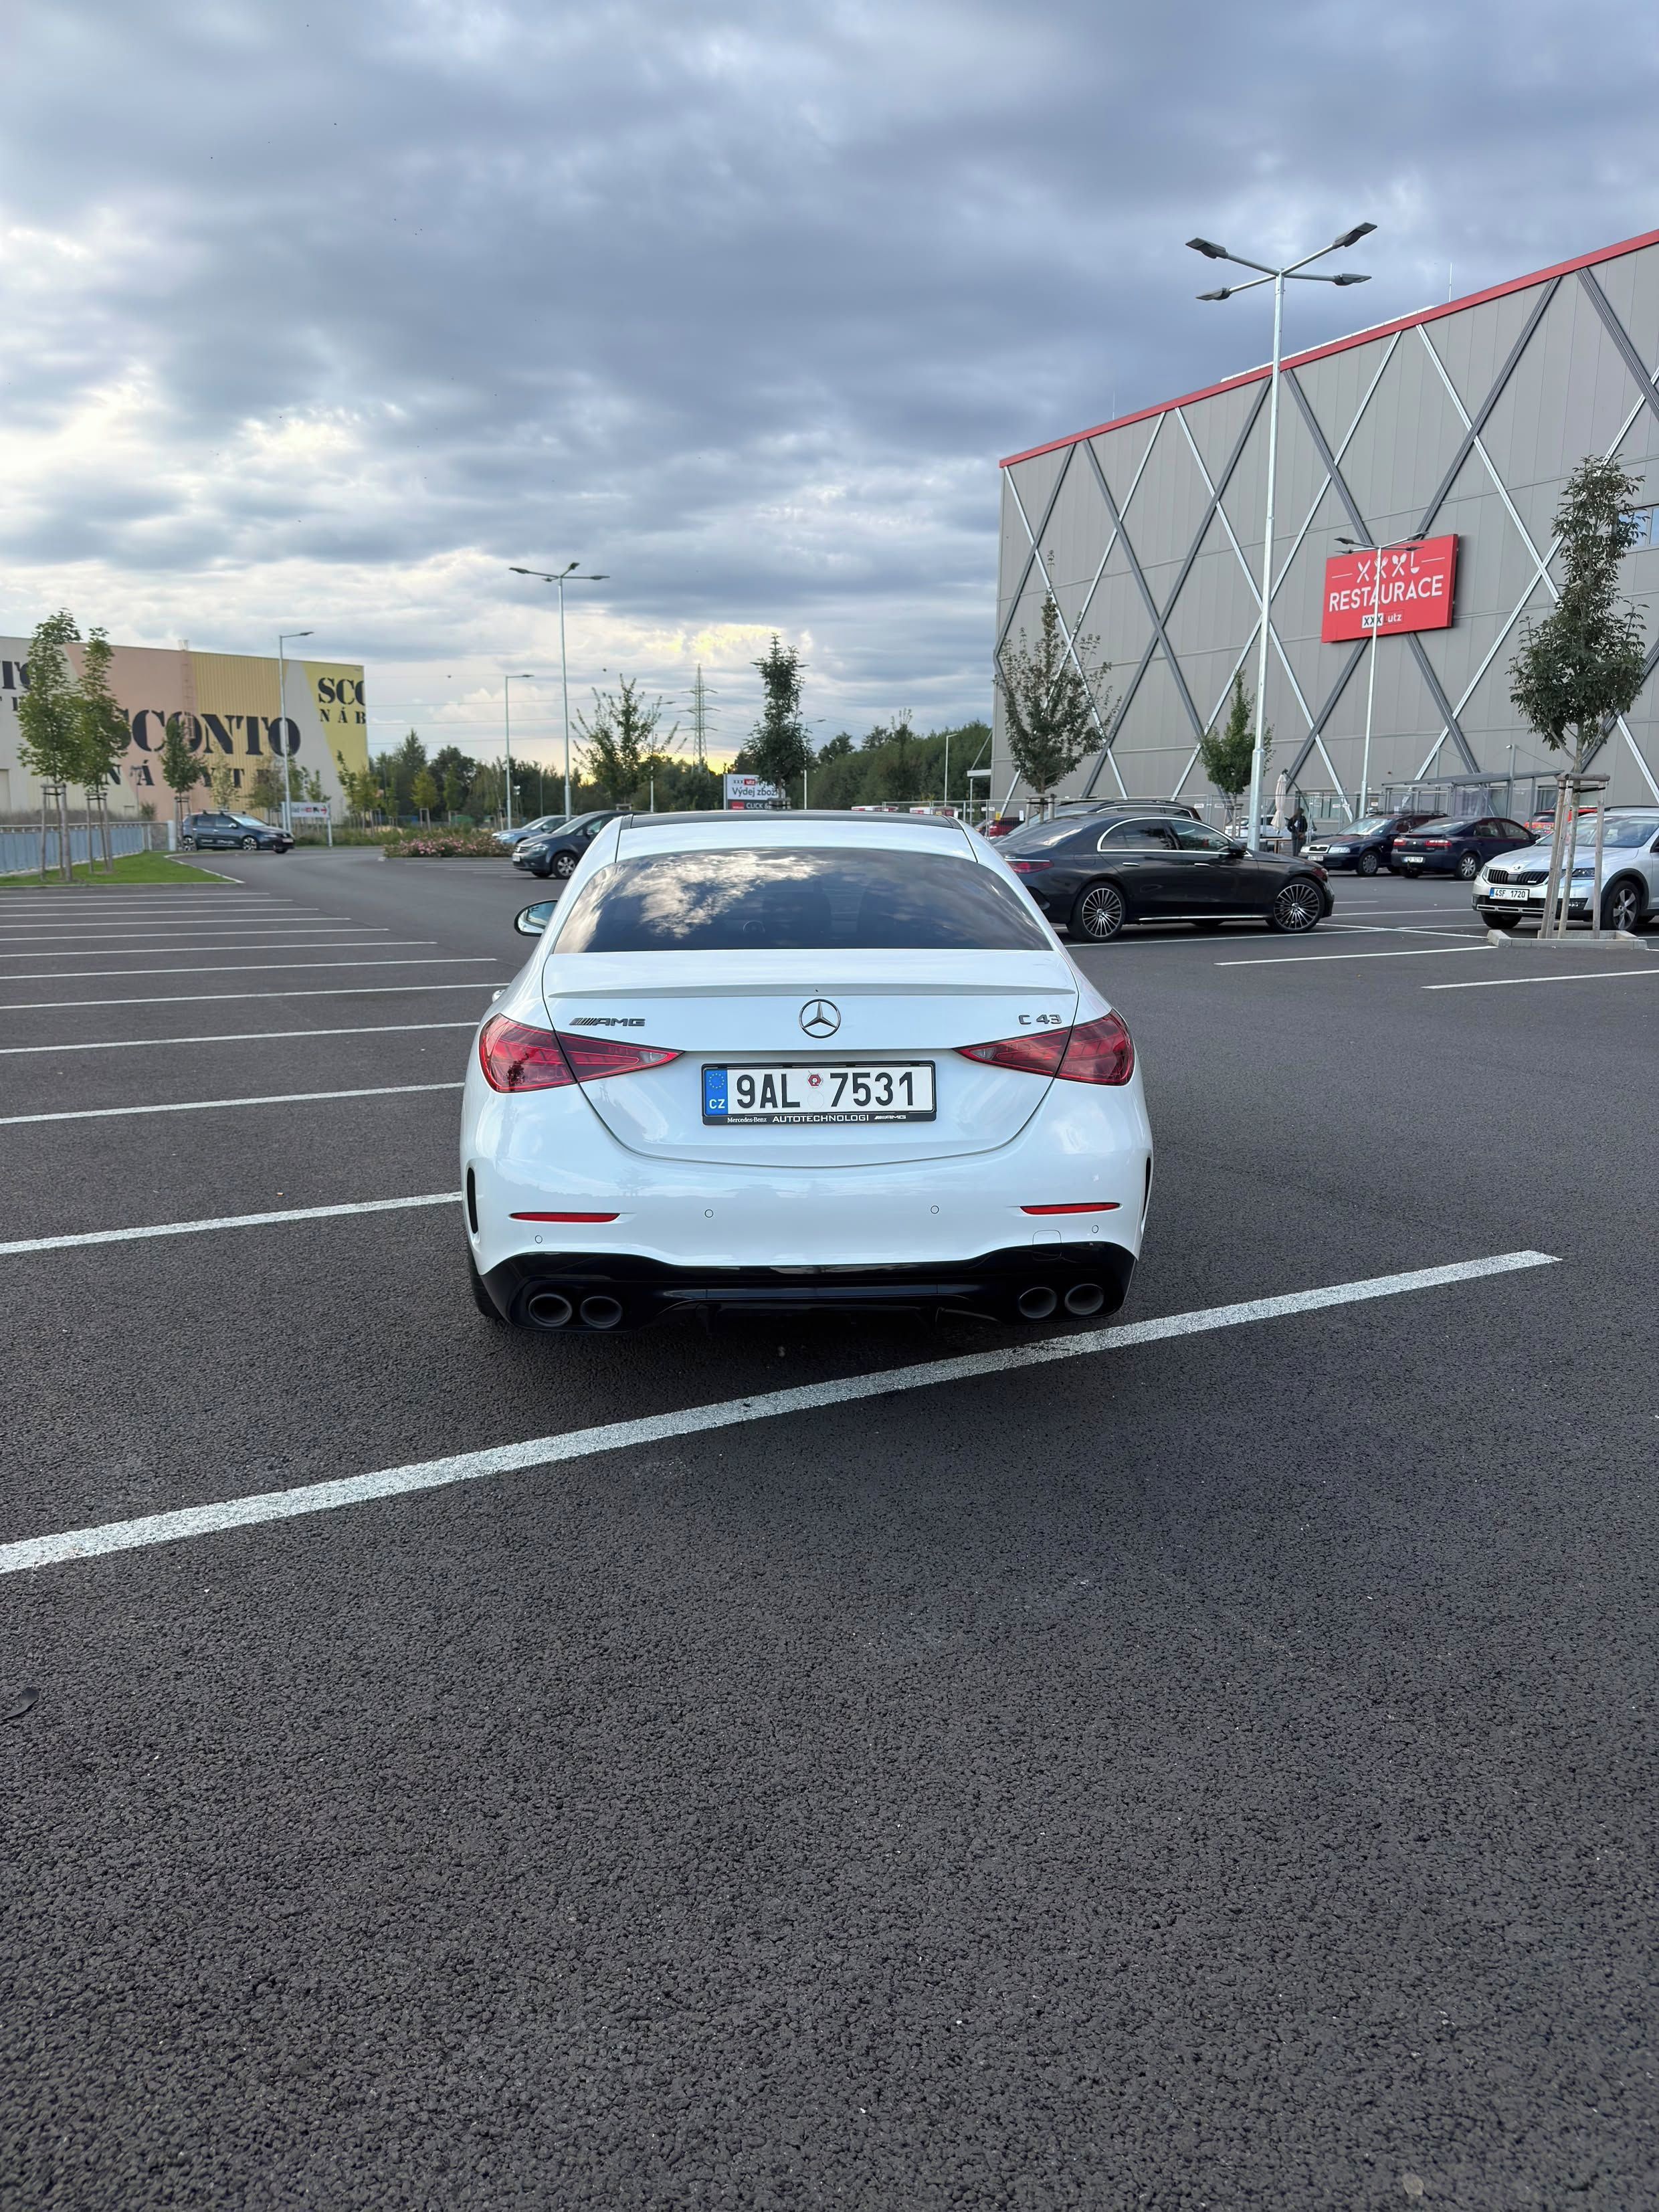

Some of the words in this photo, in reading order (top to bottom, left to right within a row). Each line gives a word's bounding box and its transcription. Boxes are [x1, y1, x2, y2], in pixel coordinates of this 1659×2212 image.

[1329, 575, 1444, 612] RESTAURACE
[732, 787, 756, 797] Výdej
[1495, 889, 1506, 897] 4SF
[1510, 890, 1526, 898] 1720
[1018, 1014, 1032, 1025] C
[1036, 1014, 1062, 1025] 43
[736, 1074, 801, 1109] 9AL
[830, 1072, 914, 1108] 7531
[709, 1098, 725, 1110] CZ
[772, 1114, 870, 1123] AUTOTECHNOLOGI
